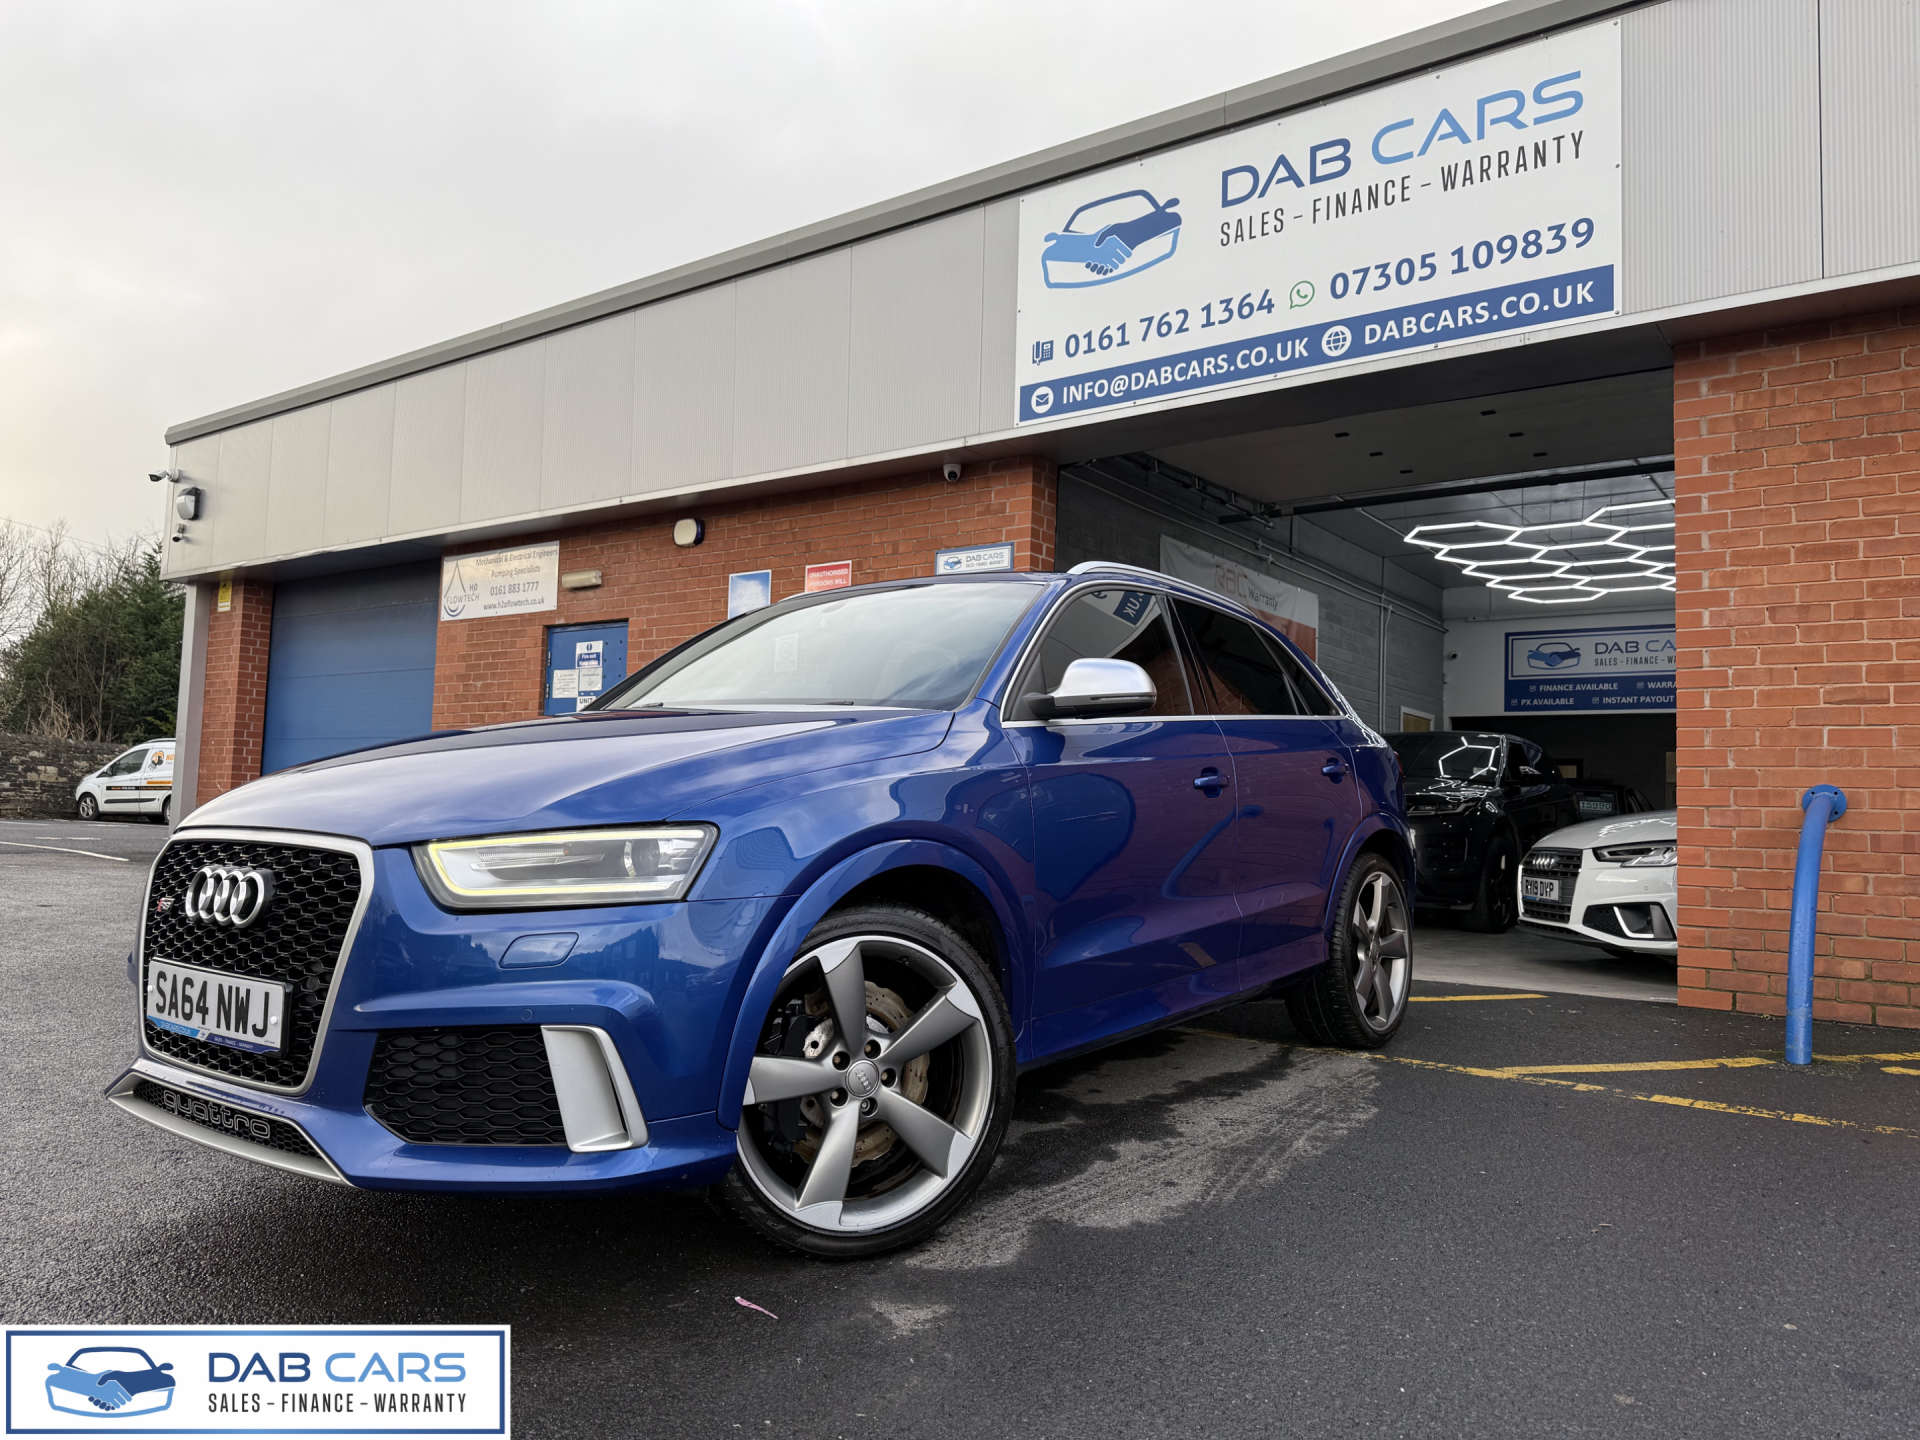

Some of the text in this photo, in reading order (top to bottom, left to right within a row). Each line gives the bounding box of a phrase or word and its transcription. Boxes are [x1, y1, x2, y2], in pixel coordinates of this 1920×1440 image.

[1220, 70, 1584, 208] DAB CARS
[1220, 207, 1285, 247] SALES
[1312, 175, 1411, 224] FINANCE
[1440, 130, 1585, 191] WARRANTY
[1065, 217, 1595, 358] 0161 762 1364 07305 109839
[1062, 280, 1595, 405] INFO@DABCARS.CO.UK DABCARS.CO.UK
[982, 551, 1004, 560] CARS
[490, 584, 506, 596] 0161
[522, 581, 539, 592] 1777
[1248, 583, 1279, 610] Warranty
[1595, 641, 1639, 655] DAB
[1594, 658, 1618, 667] SALES
[1626, 656, 1659, 665] FINANCE
[1539, 683, 1618, 692] FINANCE AVAILABLE
[579, 697, 594, 705] UNIT
[1603, 696, 1637, 704] INSTANT
[1525, 880, 1538, 895] RY19
[155, 970, 271, 1039] SA64 NWJ
[164, 1089, 272, 1140] quattro
